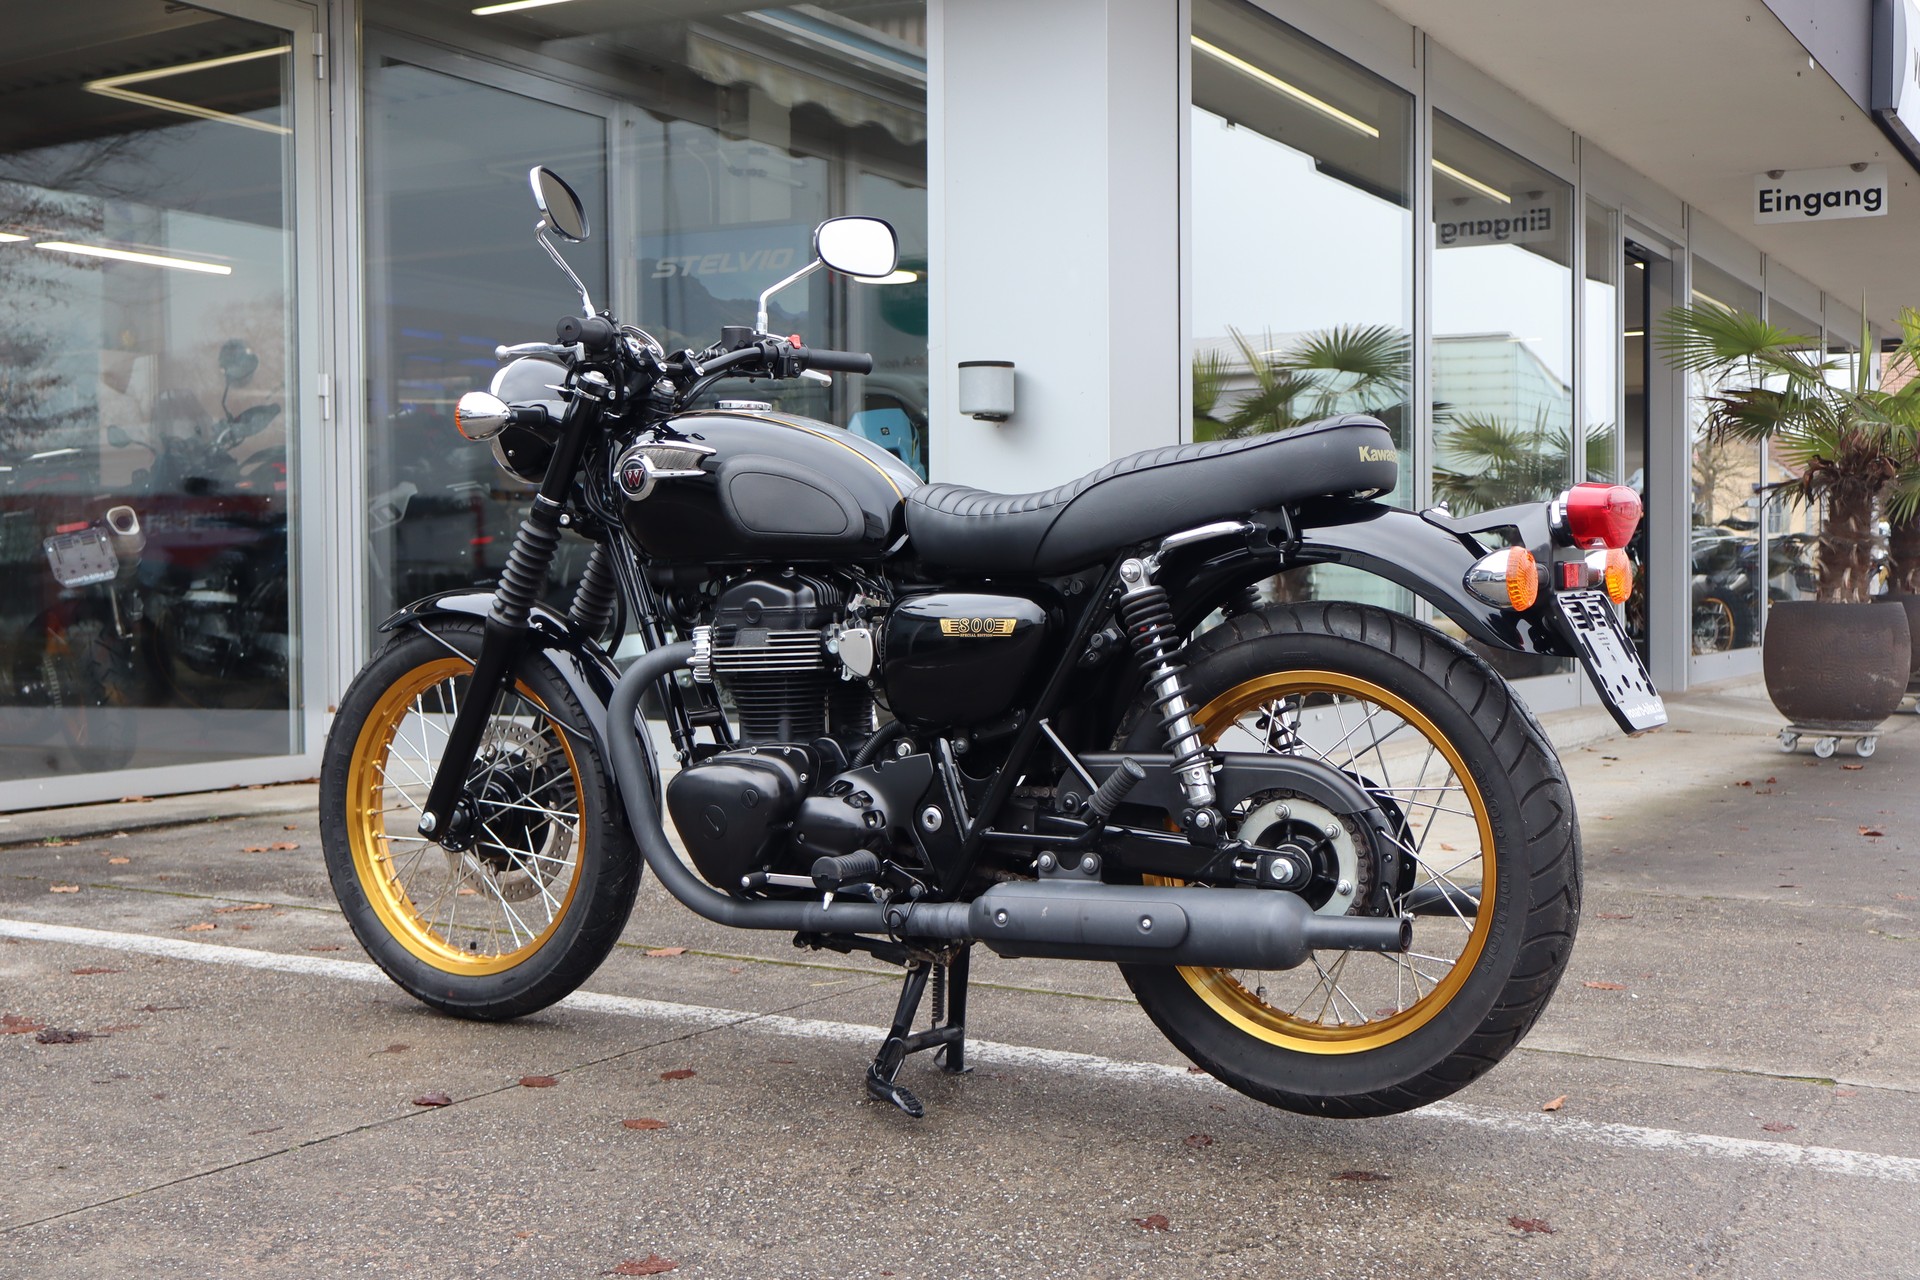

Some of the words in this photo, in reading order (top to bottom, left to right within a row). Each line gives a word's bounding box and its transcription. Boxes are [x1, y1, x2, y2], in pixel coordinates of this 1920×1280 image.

[1759, 187, 1882, 216] Eingang
[650, 247, 796, 280] STELVIO
[624, 467, 645, 488] W
[957, 617, 996, 633] 800
